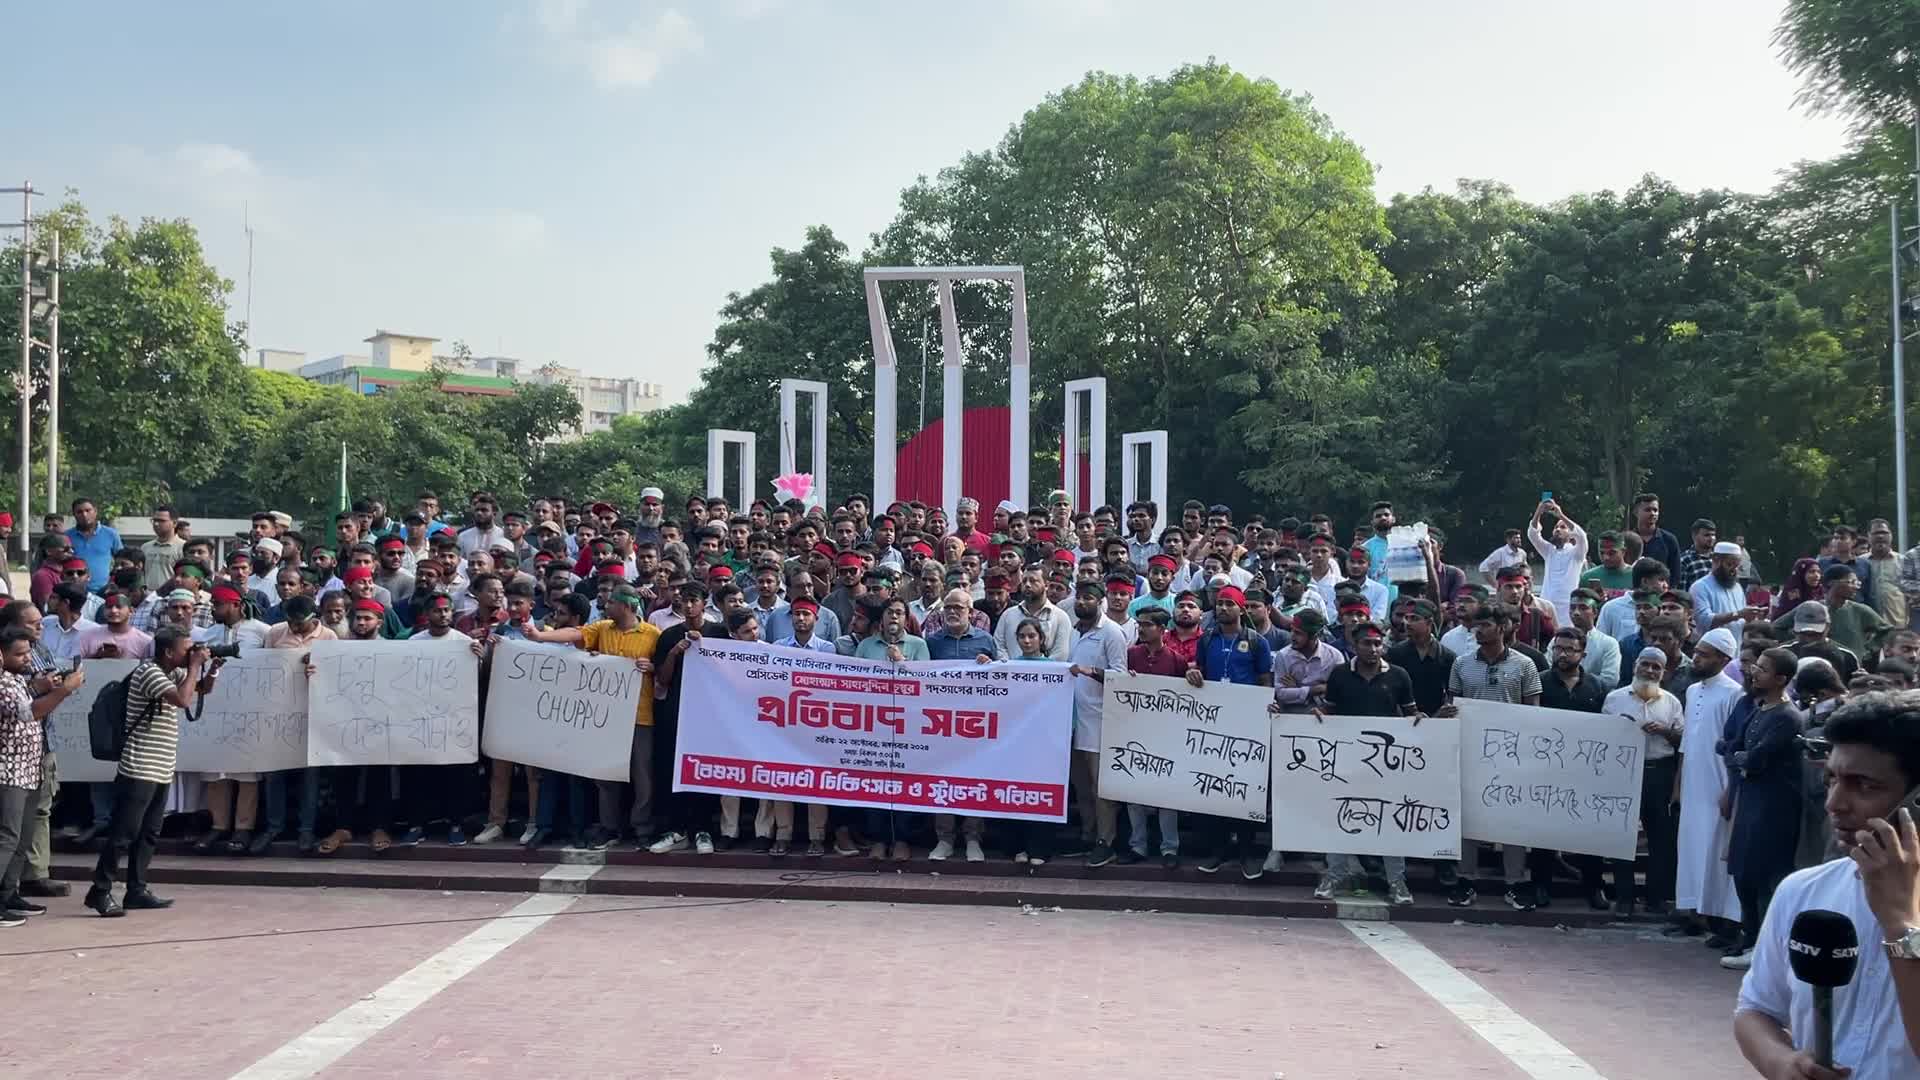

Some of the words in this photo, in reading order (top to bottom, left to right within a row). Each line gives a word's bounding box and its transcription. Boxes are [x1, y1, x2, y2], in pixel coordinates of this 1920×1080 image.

[508, 652, 567, 686] STEP
[574, 663, 639, 700] DOWN
[729, 651, 769, 665] প্রধানমন্ত্রী
[772, 655, 792, 667] শেখ
[796, 657, 832, 670] হাসিনার
[940, 670, 962, 680] করে
[1011, 672, 1038, 683] করার
[1041, 673, 1064, 684] দায়ে
[746, 669, 789, 681] প্রেসিডেন্ট
[925, 684, 973, 696] পদত্যাগের
[975, 683, 1009, 697] দাবিতে
[536, 690, 609, 729] CHUPPU
[757, 690, 905, 735] প্রতিবাদ
[921, 708, 998, 740] সভা
[1185, 728, 1267, 767] দালালেরা
[1279, 734, 1353, 784] চুপ্পু
[1357, 730, 1426, 778] হটাও
[687, 755, 747, 784] বৈষম্য
[752, 765, 816, 788] বিরোধী
[820, 770, 903, 796] চিকিৎসক
[908, 781, 923, 797] ও
[928, 779, 988, 806] স্টুডেন্ট
[993, 784, 1053, 808] পরিষদ
[1188, 771, 1248, 802] সাবধান
[1331, 796, 1392, 837] দেশ
[1392, 794, 1450, 833] বাঁচাও
[1790, 939, 1821, 957] SATV
